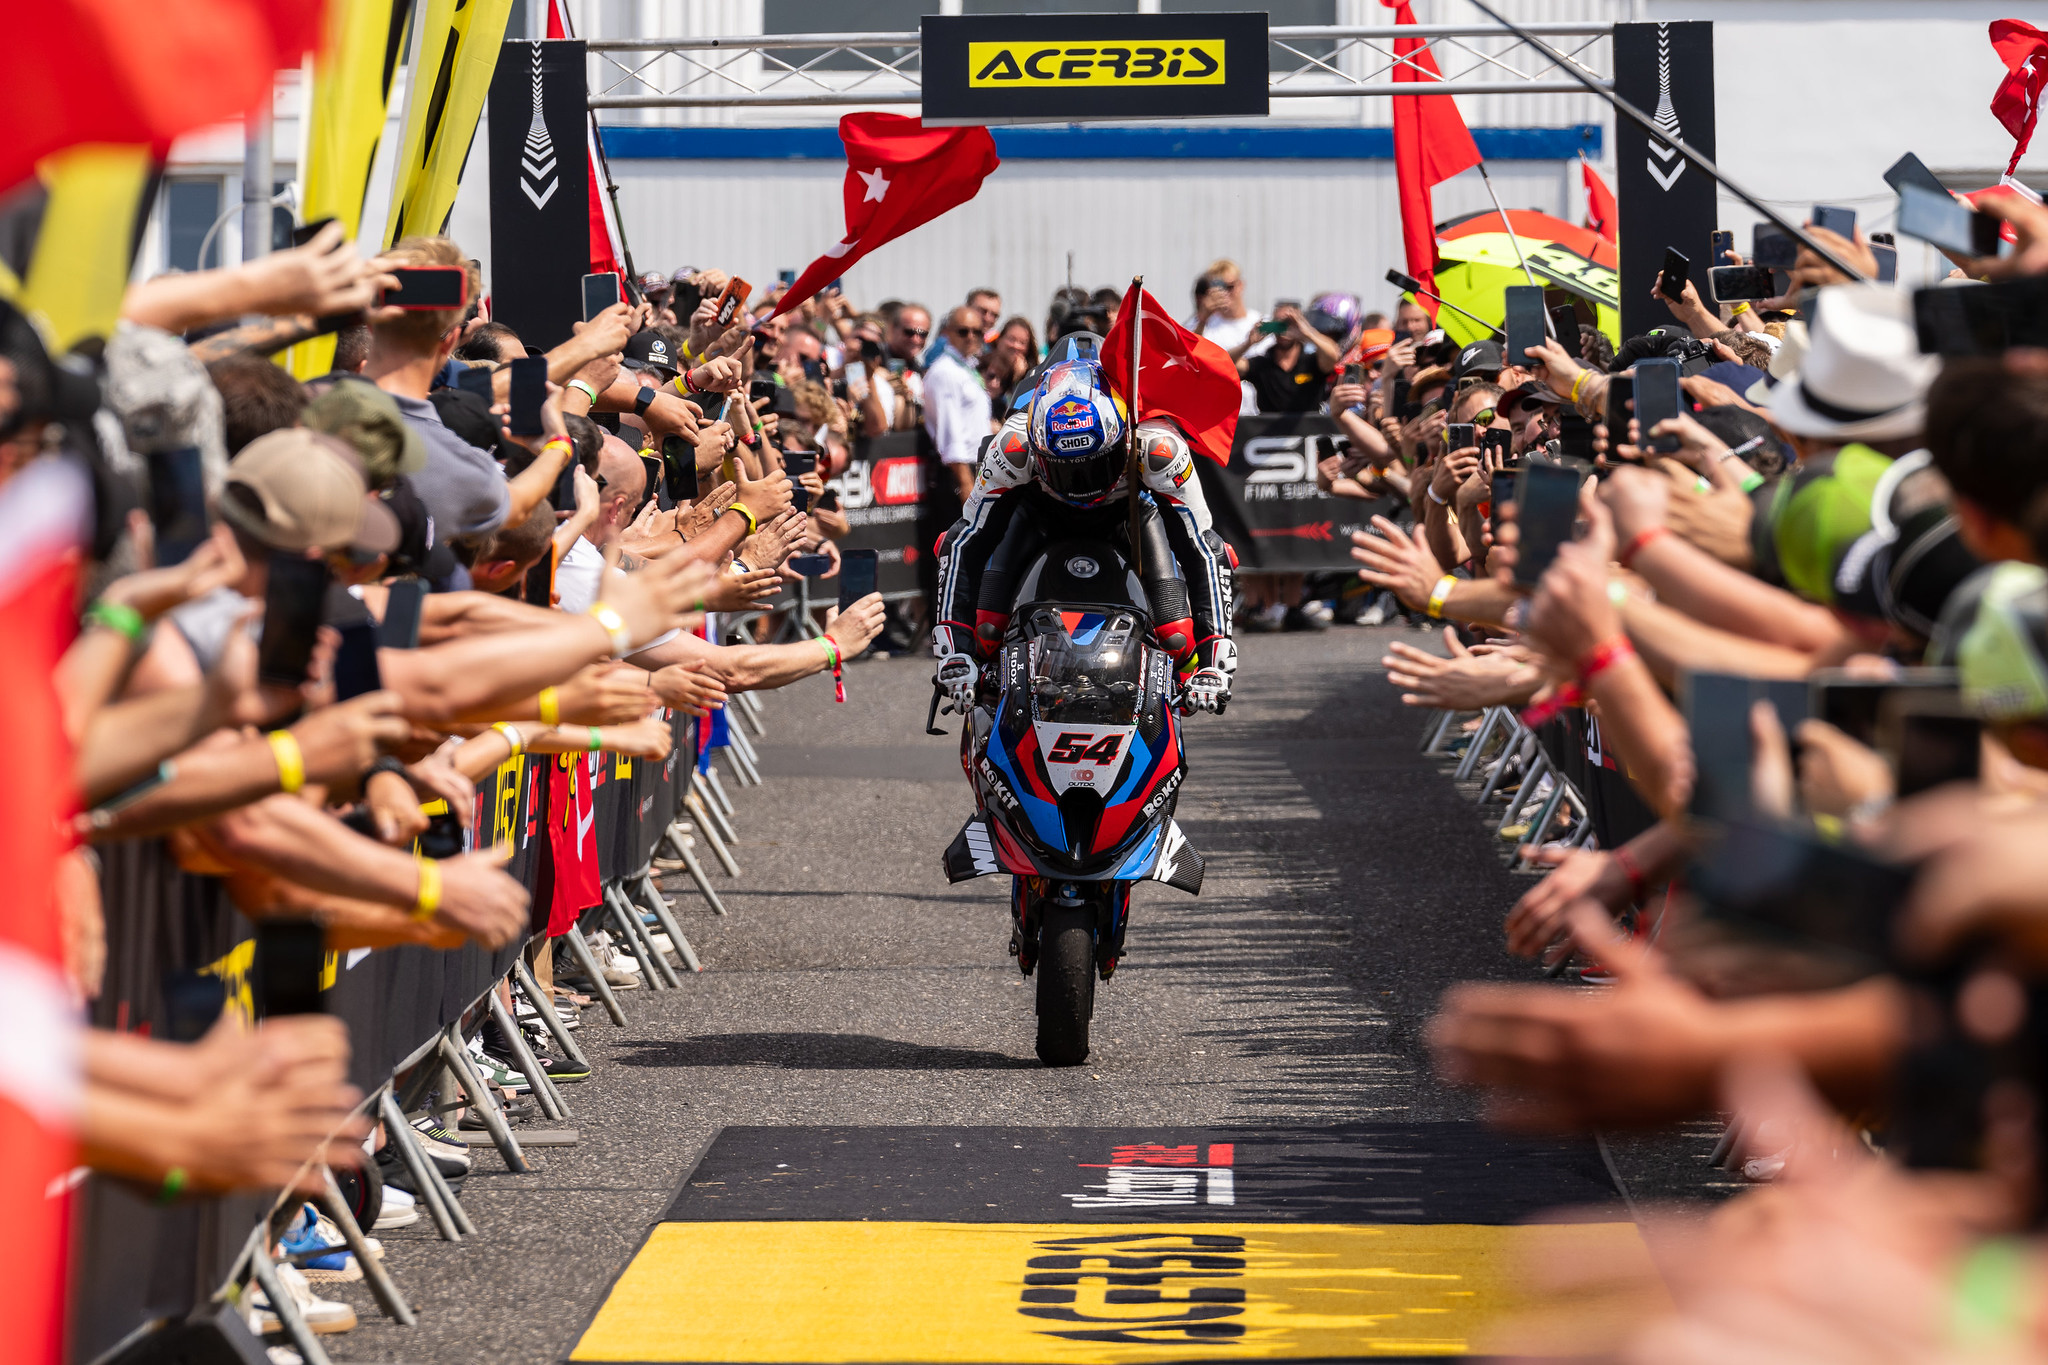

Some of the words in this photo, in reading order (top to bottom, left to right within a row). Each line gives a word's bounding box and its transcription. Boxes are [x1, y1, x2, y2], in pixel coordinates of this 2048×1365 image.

[1051, 417, 1072, 432] Red
[1075, 415, 1094, 429] Bull
[1060, 436, 1090, 449] SHOEI
[1046, 456, 1066, 464] GIVES
[1244, 483, 1279, 502] FIM
[1010, 651, 1018, 686] EDOX
[1156, 660, 1164, 694] EDOX
[1047, 731, 1125, 766] 54
